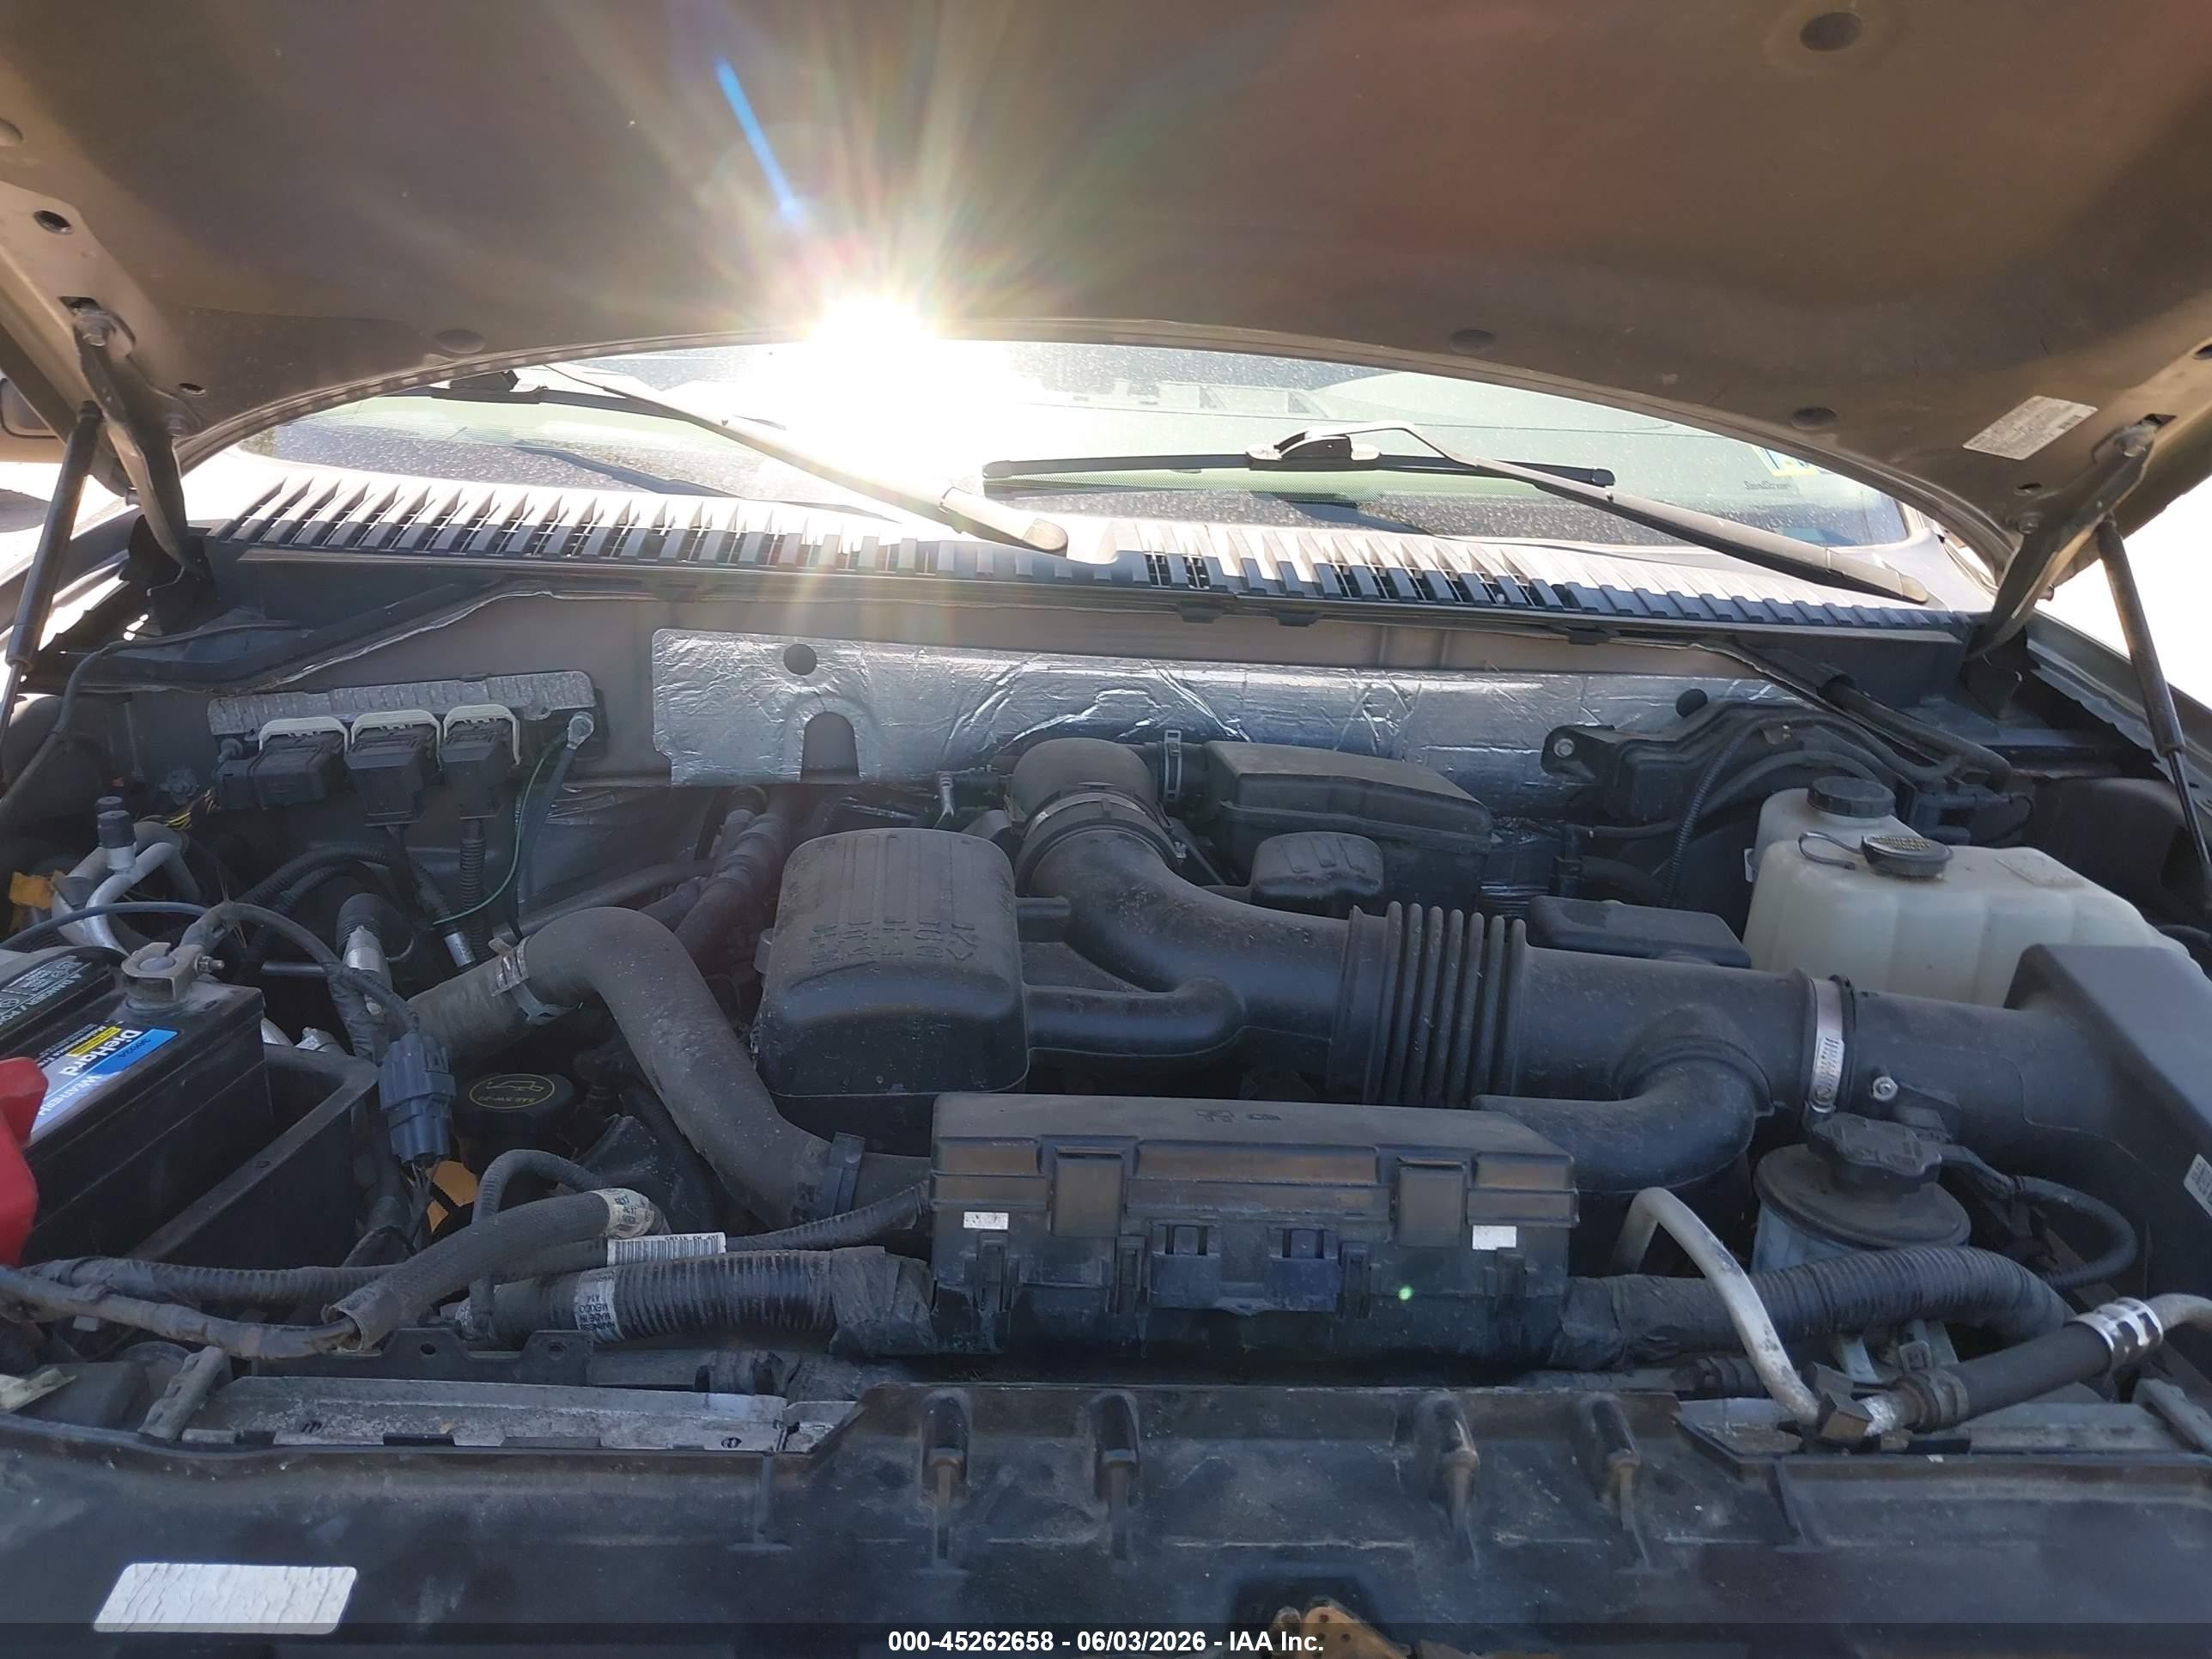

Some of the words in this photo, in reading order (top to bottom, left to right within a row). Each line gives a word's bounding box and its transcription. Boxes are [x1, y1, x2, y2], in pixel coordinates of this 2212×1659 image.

[25, 980, 76, 1006] DANGER
[59, 1030, 143, 1076] DieHard
[579, 1304, 608, 1313] MEXICO
[590, 1313, 611, 1322] MADE
